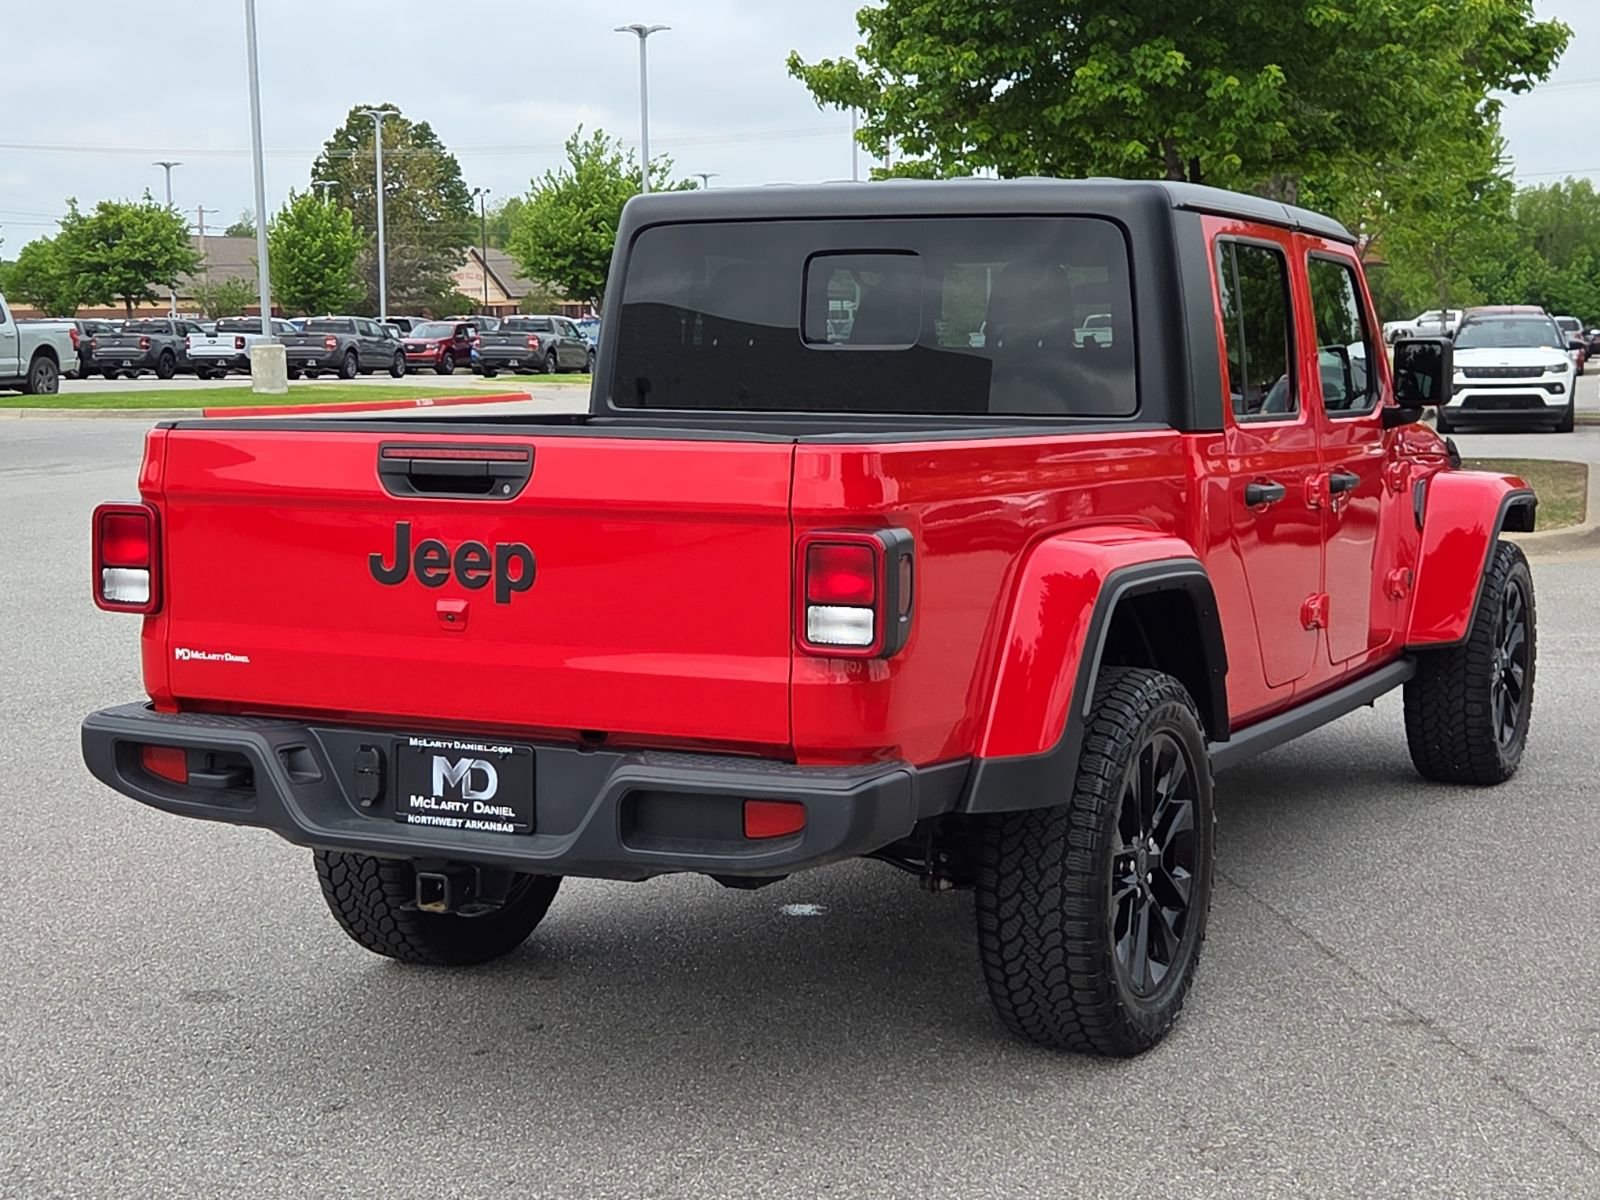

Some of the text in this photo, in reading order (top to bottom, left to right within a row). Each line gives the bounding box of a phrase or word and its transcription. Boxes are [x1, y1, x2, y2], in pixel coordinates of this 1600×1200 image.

[368, 520, 537, 605] Jeep
[432, 755, 498, 800] MD
[410, 795, 516, 817] McLARTY DANIEL
[407, 814, 514, 833] NORTHWEST ARKANSAS
